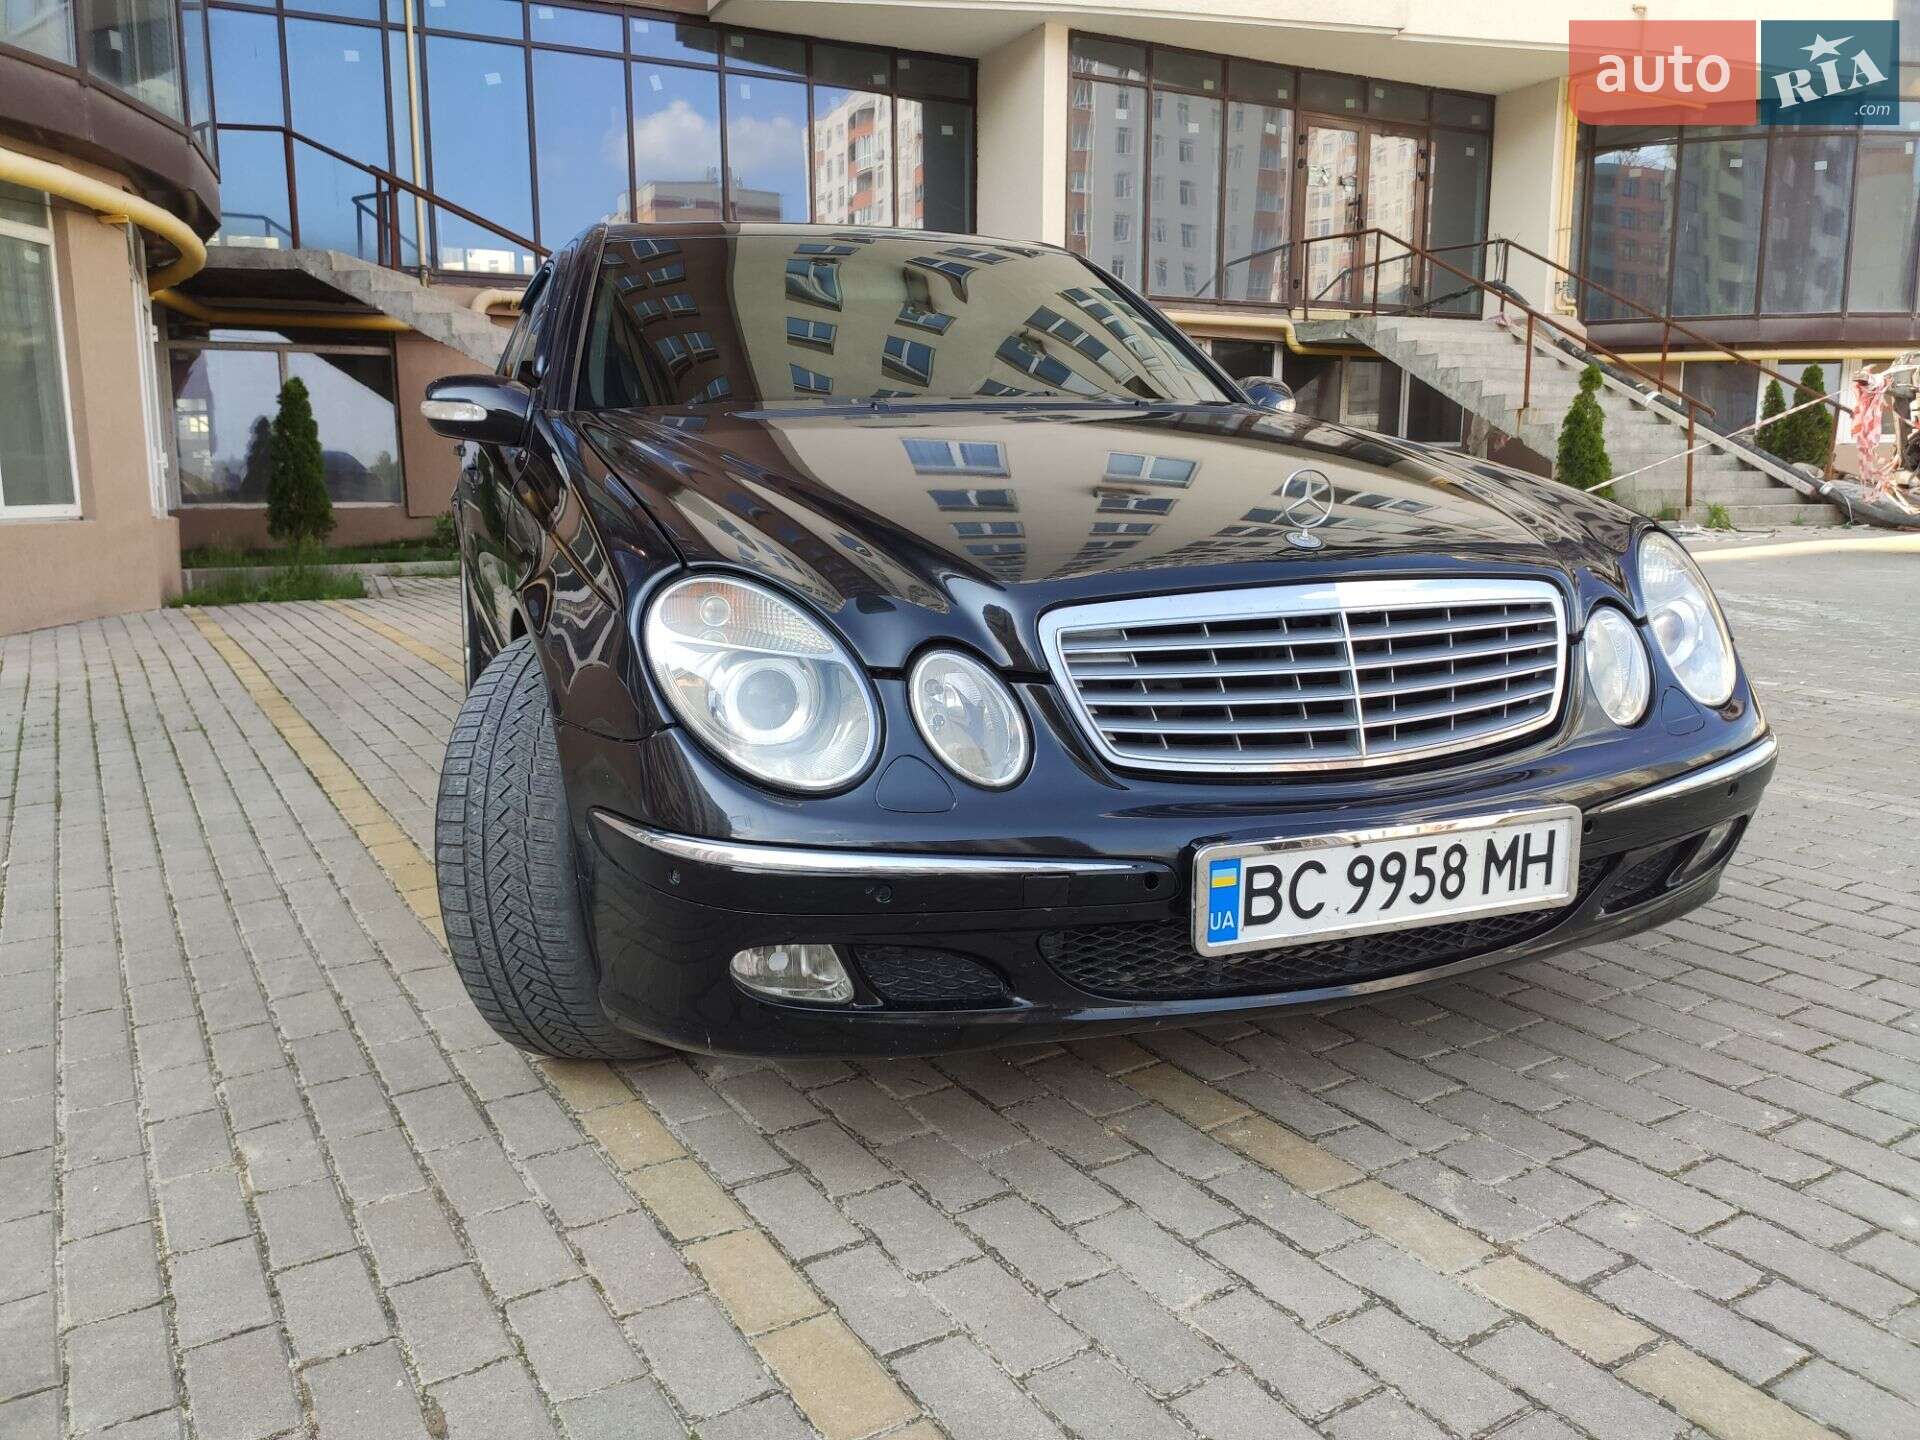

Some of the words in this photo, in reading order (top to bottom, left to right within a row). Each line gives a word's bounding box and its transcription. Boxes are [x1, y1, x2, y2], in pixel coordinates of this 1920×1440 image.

[1242, 860, 1327, 927] BC
[1346, 843, 1468, 914] 9958
[1482, 830, 1556, 896] MH
[1209, 911, 1235, 931] UA
